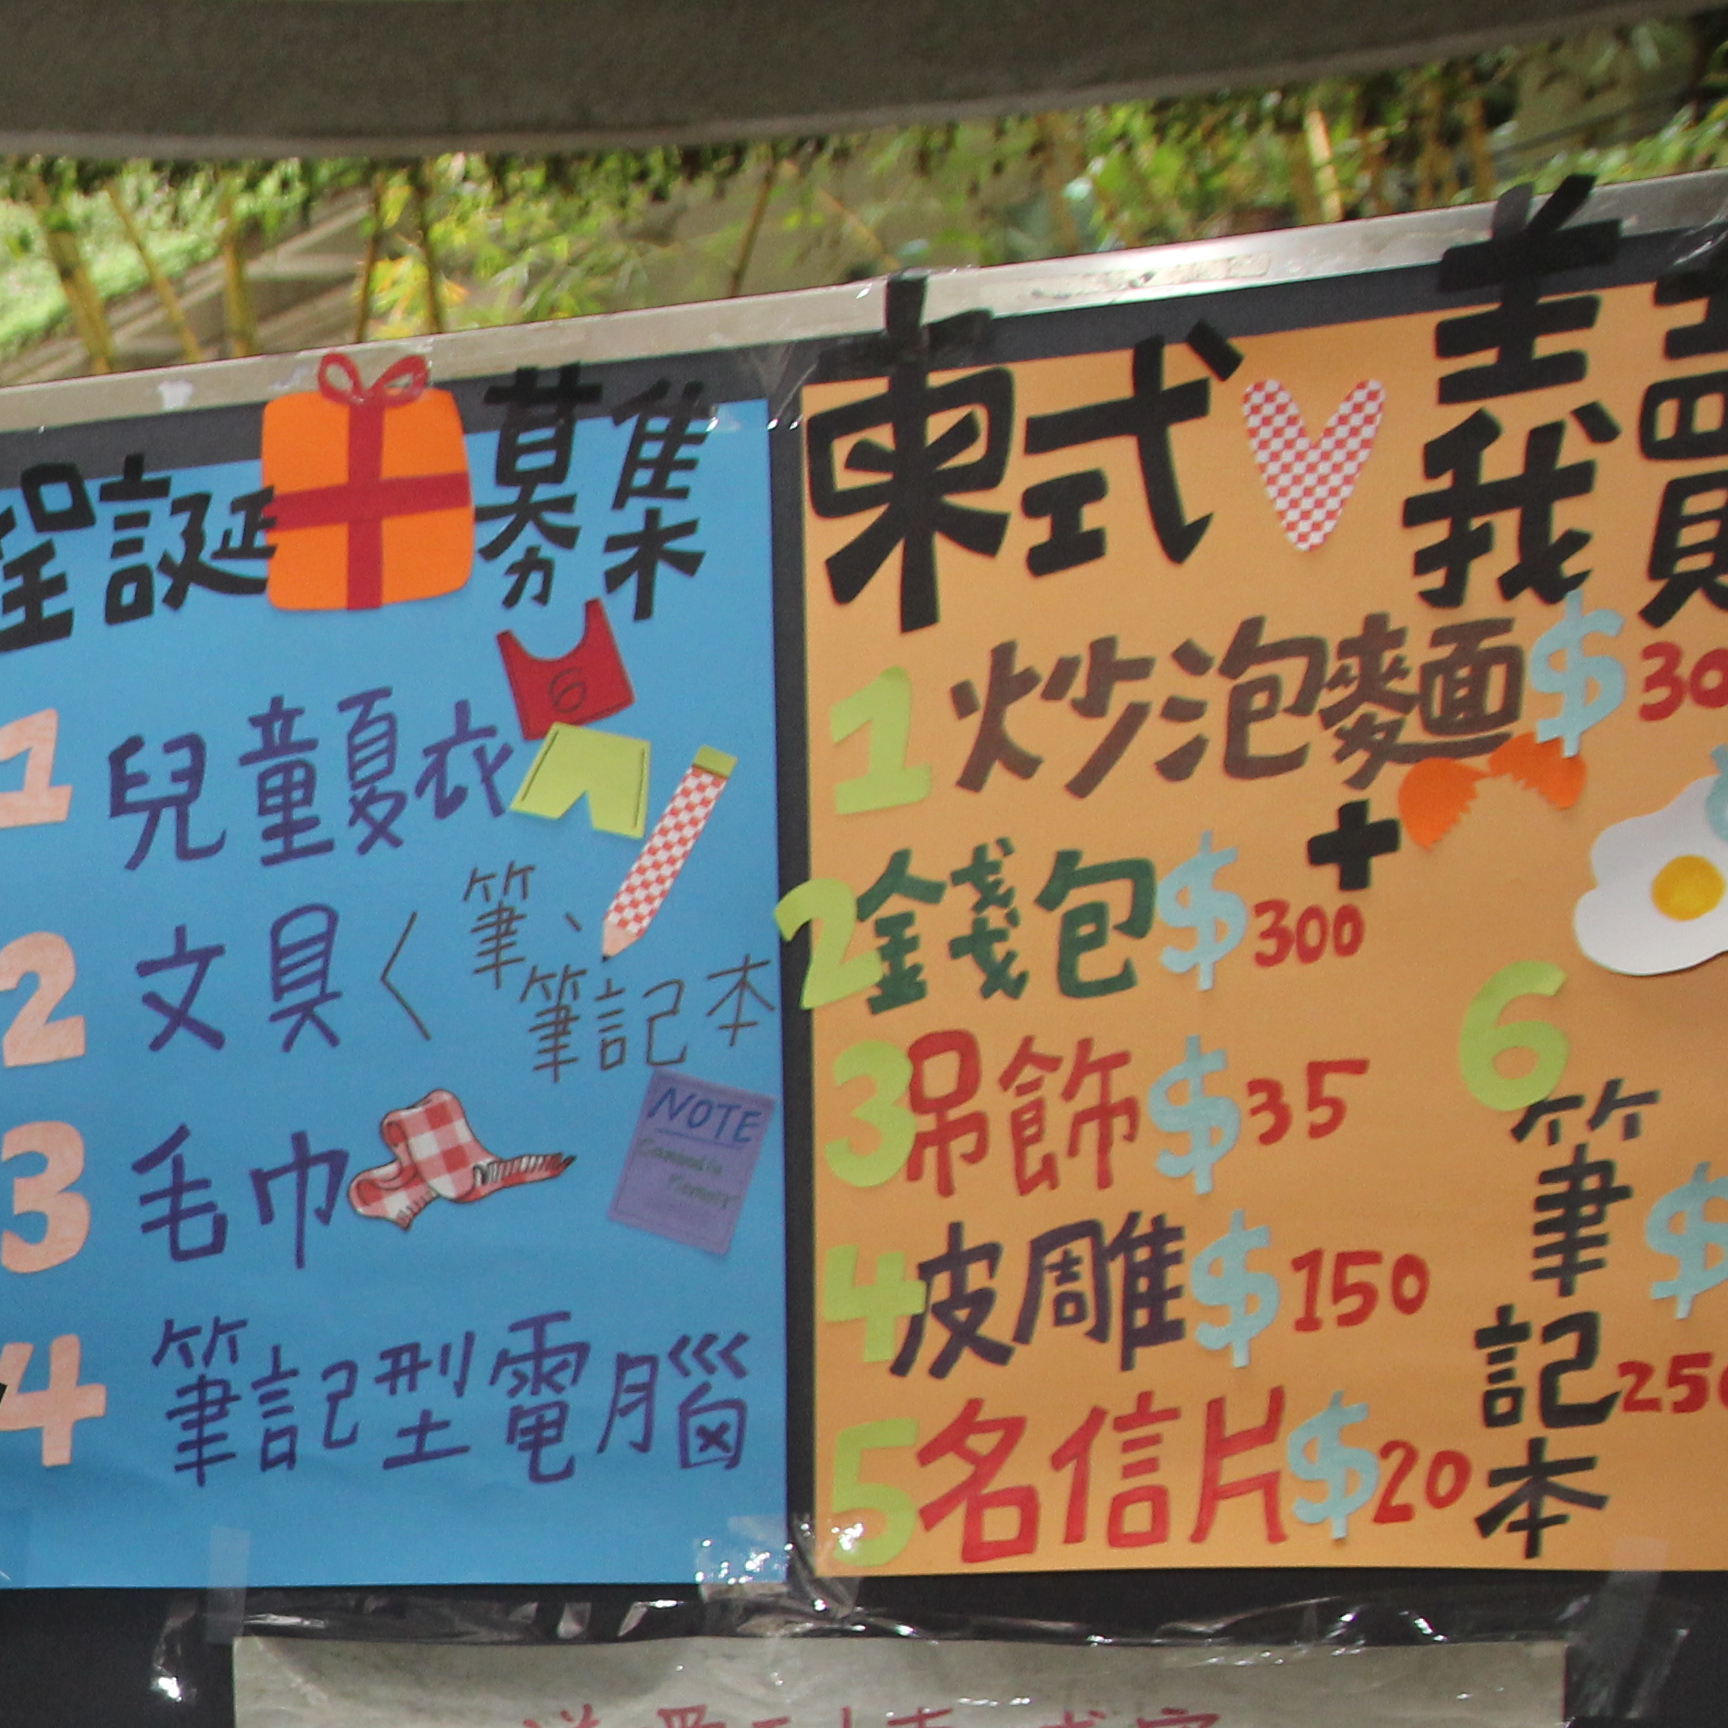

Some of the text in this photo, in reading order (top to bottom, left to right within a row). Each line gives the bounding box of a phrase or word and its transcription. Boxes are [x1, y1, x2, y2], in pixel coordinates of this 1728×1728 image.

[473, 362, 718, 622] 募集
[107, 686, 514, 870] 兒童夏衣
[830, 666, 933, 816] 1
[773, 877, 885, 1010] 2
[857, 837, 1157, 1015] 錢包
[520, 954, 775, 1082] 筆記本
[1458, 960, 1571, 1111] 6
[0, 1121, 348, 1275] 3 毛巾
[647, 1087, 762, 1142] NOTE
[824, 1040, 918, 1188] 3
[906, 1029, 1140, 1199] 吊飾
[823, 1244, 928, 1363] 4
[890, 1210, 1187, 1380] 皮雕
[1474, 1077, 1662, 1560] 筆記本
[151, 1310, 752, 1489] 筆記型電腦
[1617, 1352, 1728, 1414] 25
[832, 1417, 920, 1568] 5
[915, 1386, 1289, 1566] 名信片
